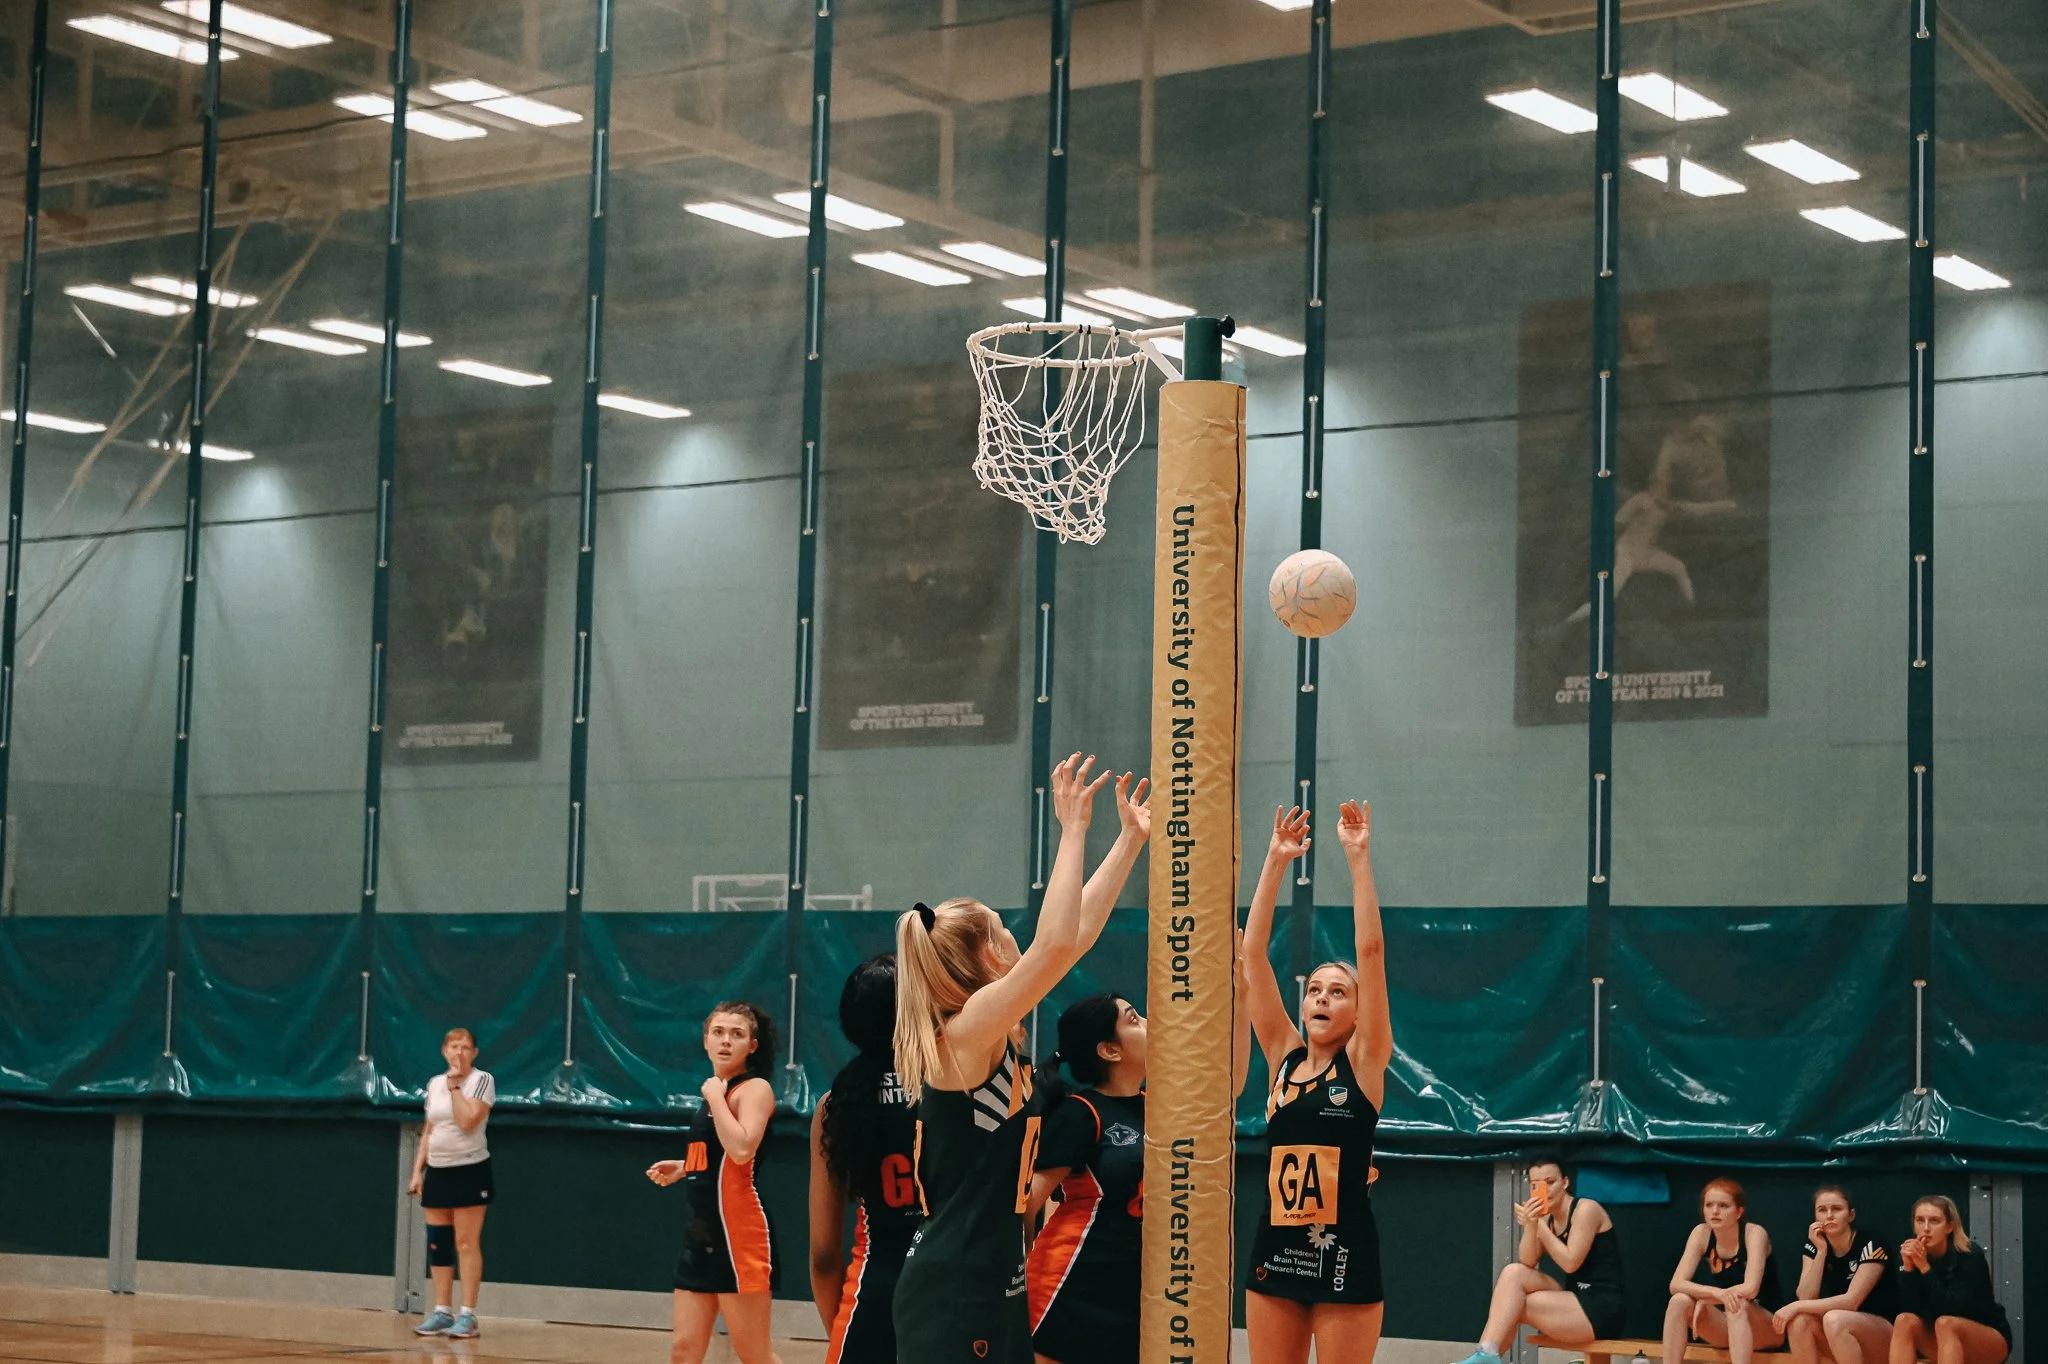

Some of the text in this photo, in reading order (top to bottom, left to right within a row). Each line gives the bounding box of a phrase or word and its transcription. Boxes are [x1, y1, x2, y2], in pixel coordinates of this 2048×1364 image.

[1556, 690, 1575, 703] OF
[1565, 671, 1711, 689] SPOS UNIVERSITY
[1167, 504, 1196, 1002] University of Nottingham Sport
[881, 1153, 919, 1208] G
[1278, 1152, 1324, 1211] GA
[1165, 1137, 1195, 1308] University
[1263, 1261, 1317, 1278] Research Centre
[1273, 1255, 1319, 1268] Brain Tumour
[1284, 1248, 1319, 1259] Children's
[1333, 1245, 1349, 1291] COGLEY
[1170, 1314, 1195, 1348] of
